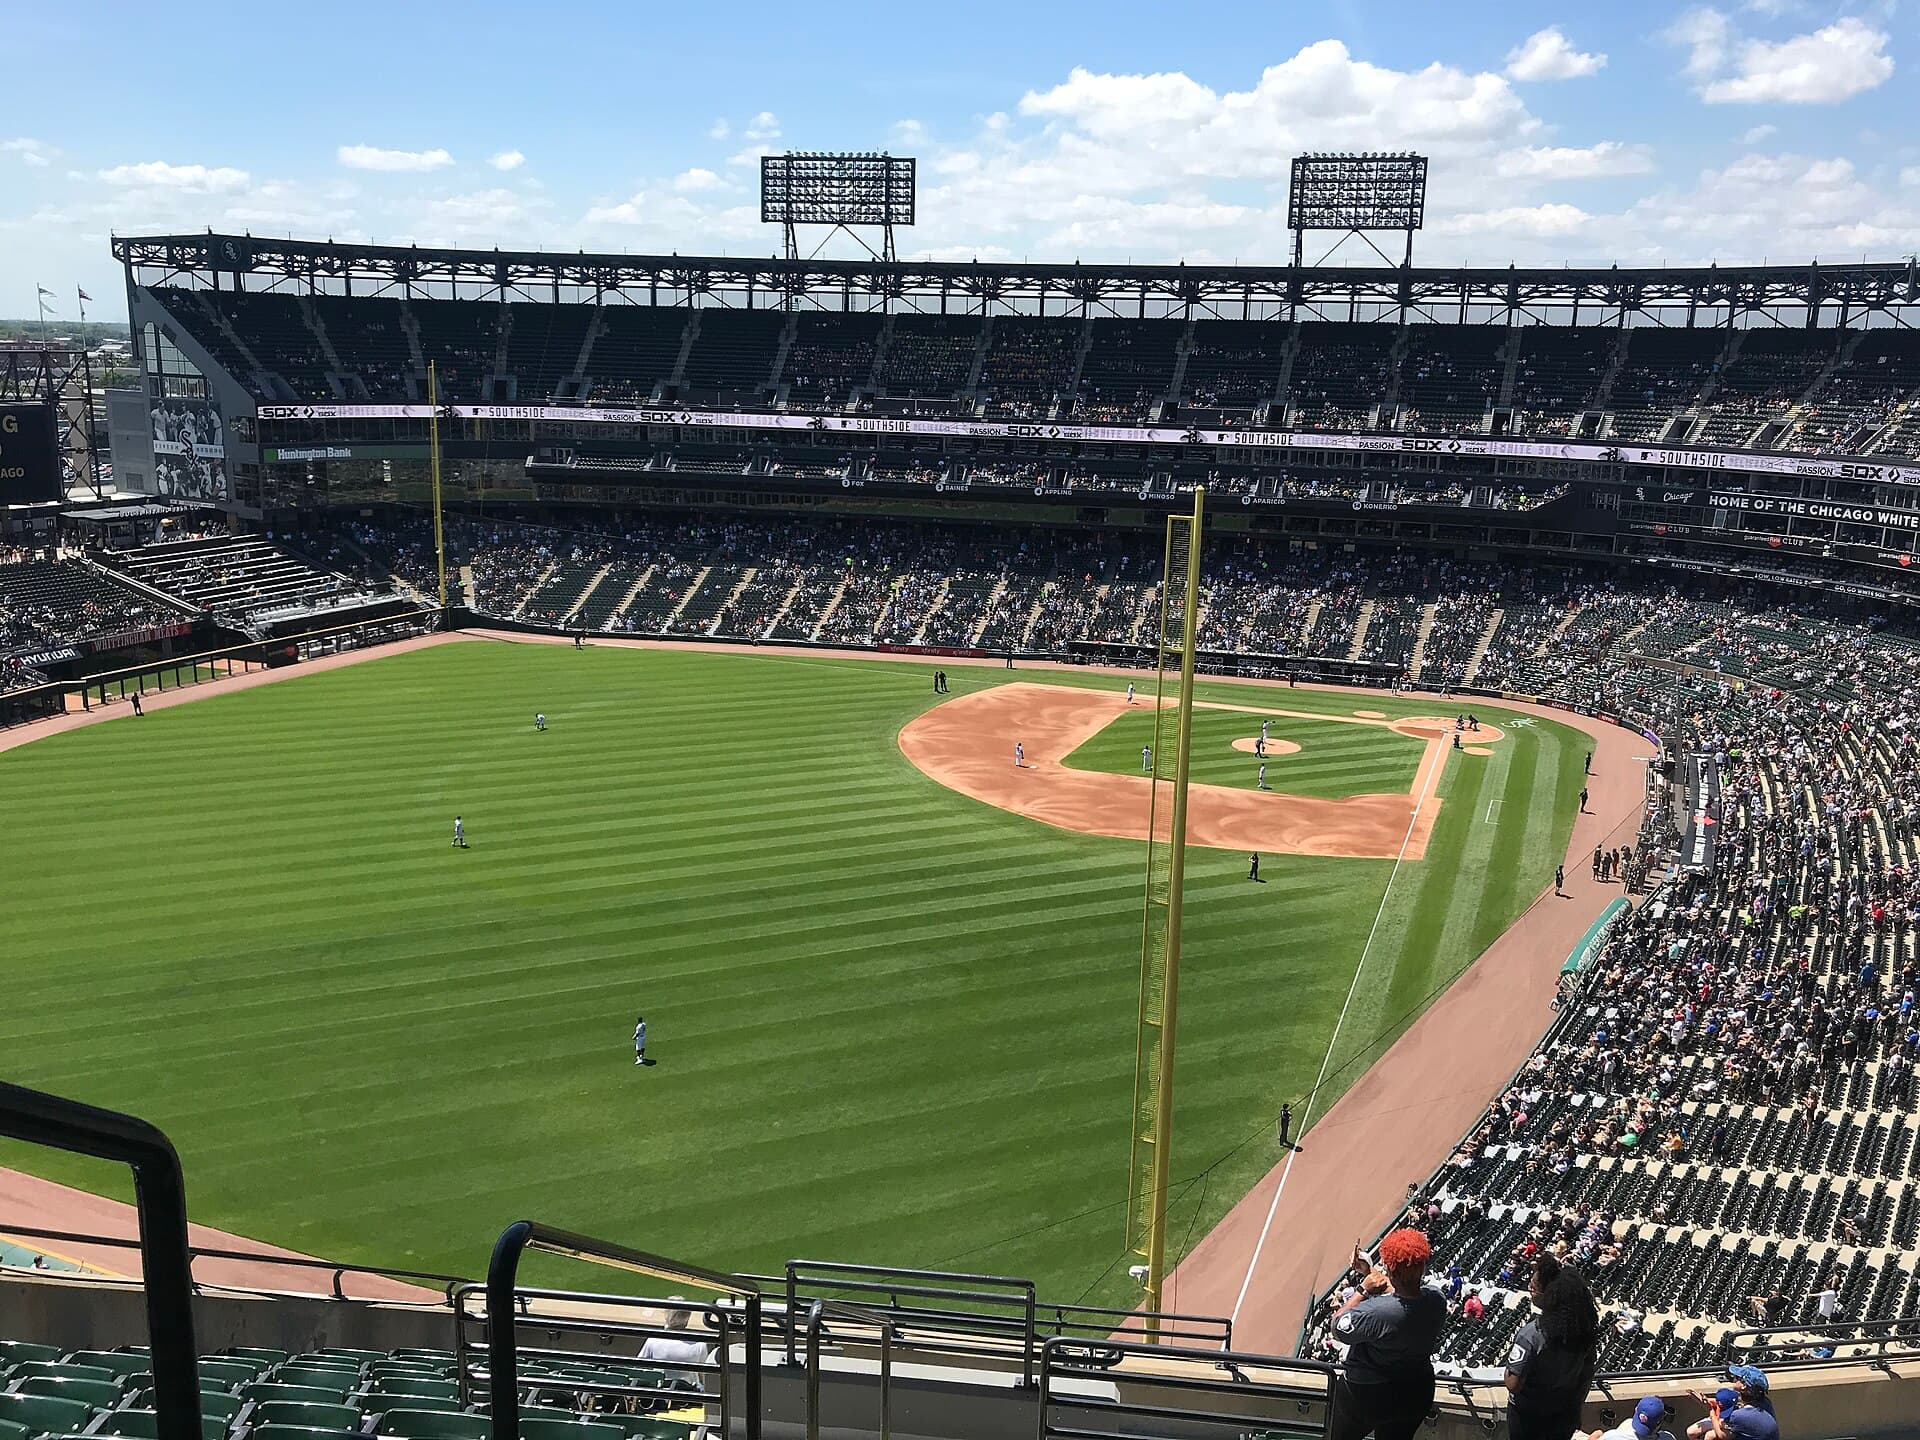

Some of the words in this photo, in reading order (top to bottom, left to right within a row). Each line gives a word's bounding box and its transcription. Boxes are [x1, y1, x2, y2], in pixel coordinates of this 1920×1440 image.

[263, 407, 298, 418] SOX
[488, 407, 545, 418] SOUTHSIDE
[640, 412, 676, 423] SOX
[856, 419, 911, 431] SOUTHSIDE
[969, 427, 1001, 436] PASSION
[1007, 426, 1043, 437] SOX
[1234, 433, 1294, 446] SOUTHSIDE
[1358, 441, 1396, 450] PASSION
[1401, 439, 1443, 451] SOX
[277, 448, 326, 460] Huntington
[327, 447, 351, 457] Bank
[1659, 452, 1726, 467] SOUTHSIDE
[1796, 465, 1834, 475] PASSION
[1840, 464, 1884, 479] SOX
[1044, 488, 1073, 496] APPLING
[1663, 491, 1694, 503] Chicago
[1363, 503, 1398, 511] KONERKO
[1709, 495, 1749, 508] HOME
[1754, 499, 1774, 510] OF
[1779, 501, 1806, 514] THE
[1809, 504, 1873, 521] CHICAGO
[1878, 511, 1919, 528] WHITE
[1667, 526, 1690, 534] CLUB
[1782, 537, 1804, 547] CLUB
[95, 633, 151, 651] WHITTINGHAM
[154, 627, 179, 641] MEATS
[20, 648, 76, 665] HYUNDAI
[1237, 658, 1271, 667] GEICO
